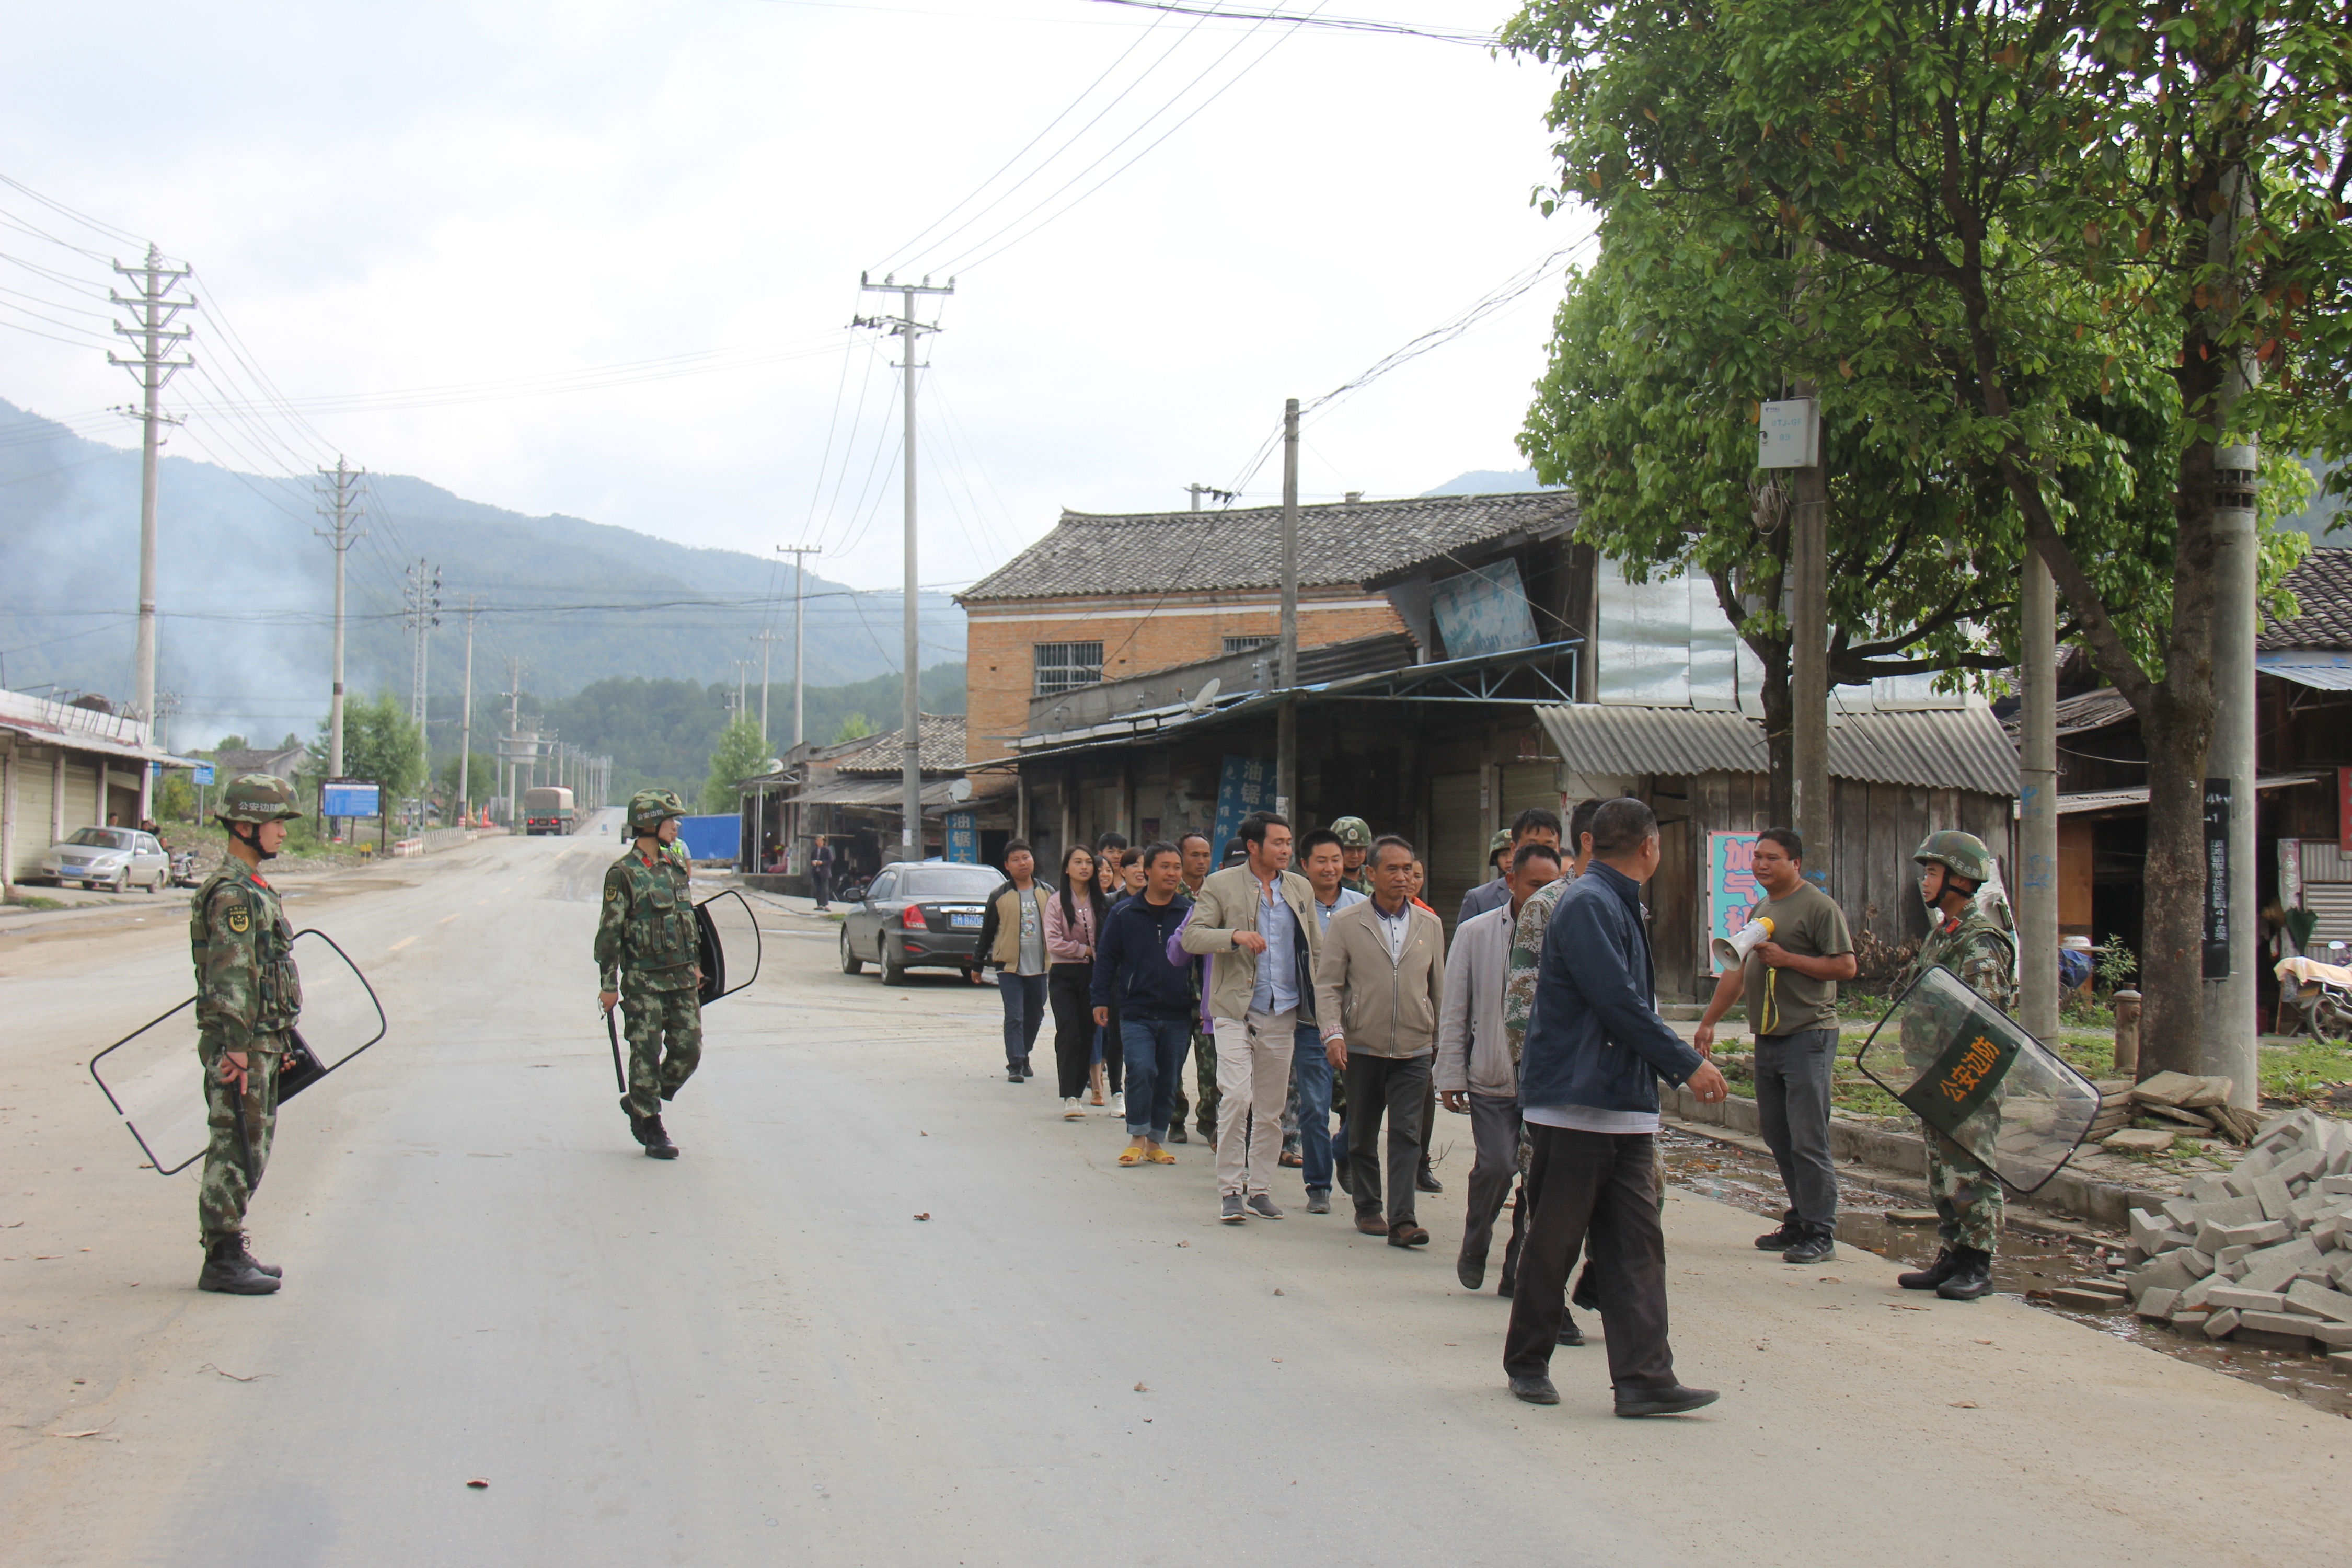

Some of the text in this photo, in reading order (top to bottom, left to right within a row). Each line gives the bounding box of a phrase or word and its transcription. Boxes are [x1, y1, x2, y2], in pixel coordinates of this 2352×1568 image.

[238, 801, 279, 812] 公安边防
[1949, 855, 1979, 878] 公安边防
[1940, 1035, 2001, 1102] 公安边防
